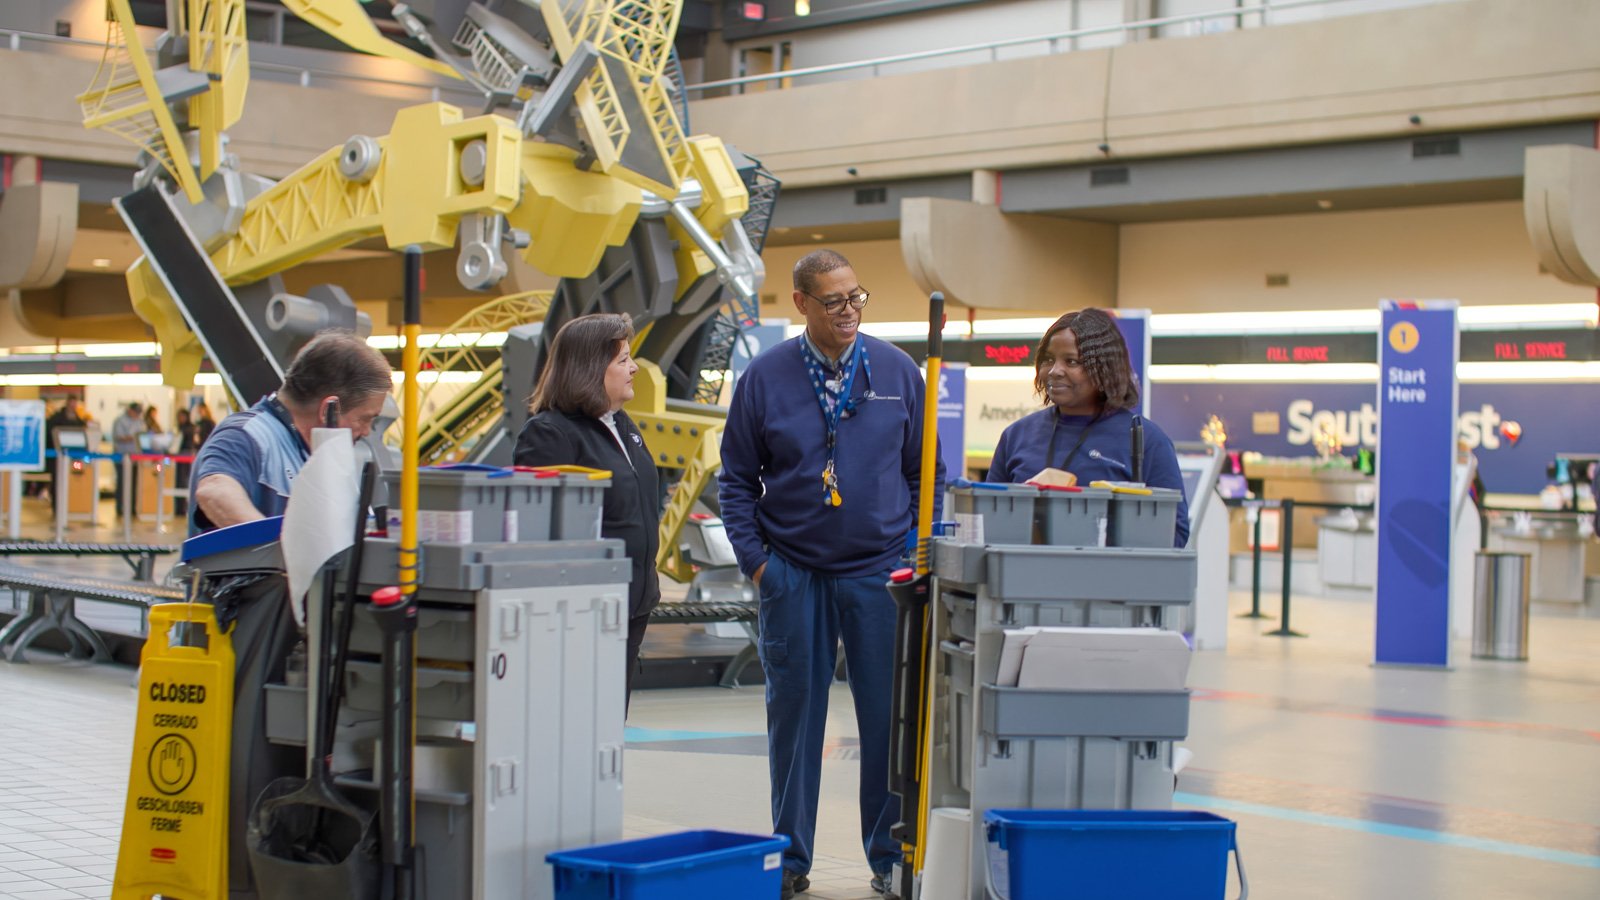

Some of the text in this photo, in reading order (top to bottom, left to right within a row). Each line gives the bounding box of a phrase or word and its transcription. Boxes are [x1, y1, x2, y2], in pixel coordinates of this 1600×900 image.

[1400, 330, 1407, 345] 1
[1266, 346, 1328, 362] FULL SERVICE
[1494, 341, 1566, 360] FULL SERVICE
[1388, 366, 1426, 385] Start
[1388, 385, 1426, 403] Here
[149, 681, 207, 704] CLOSED
[153, 713, 199, 730] CERRADO
[136, 796, 205, 816] GESCHLOSSEN
